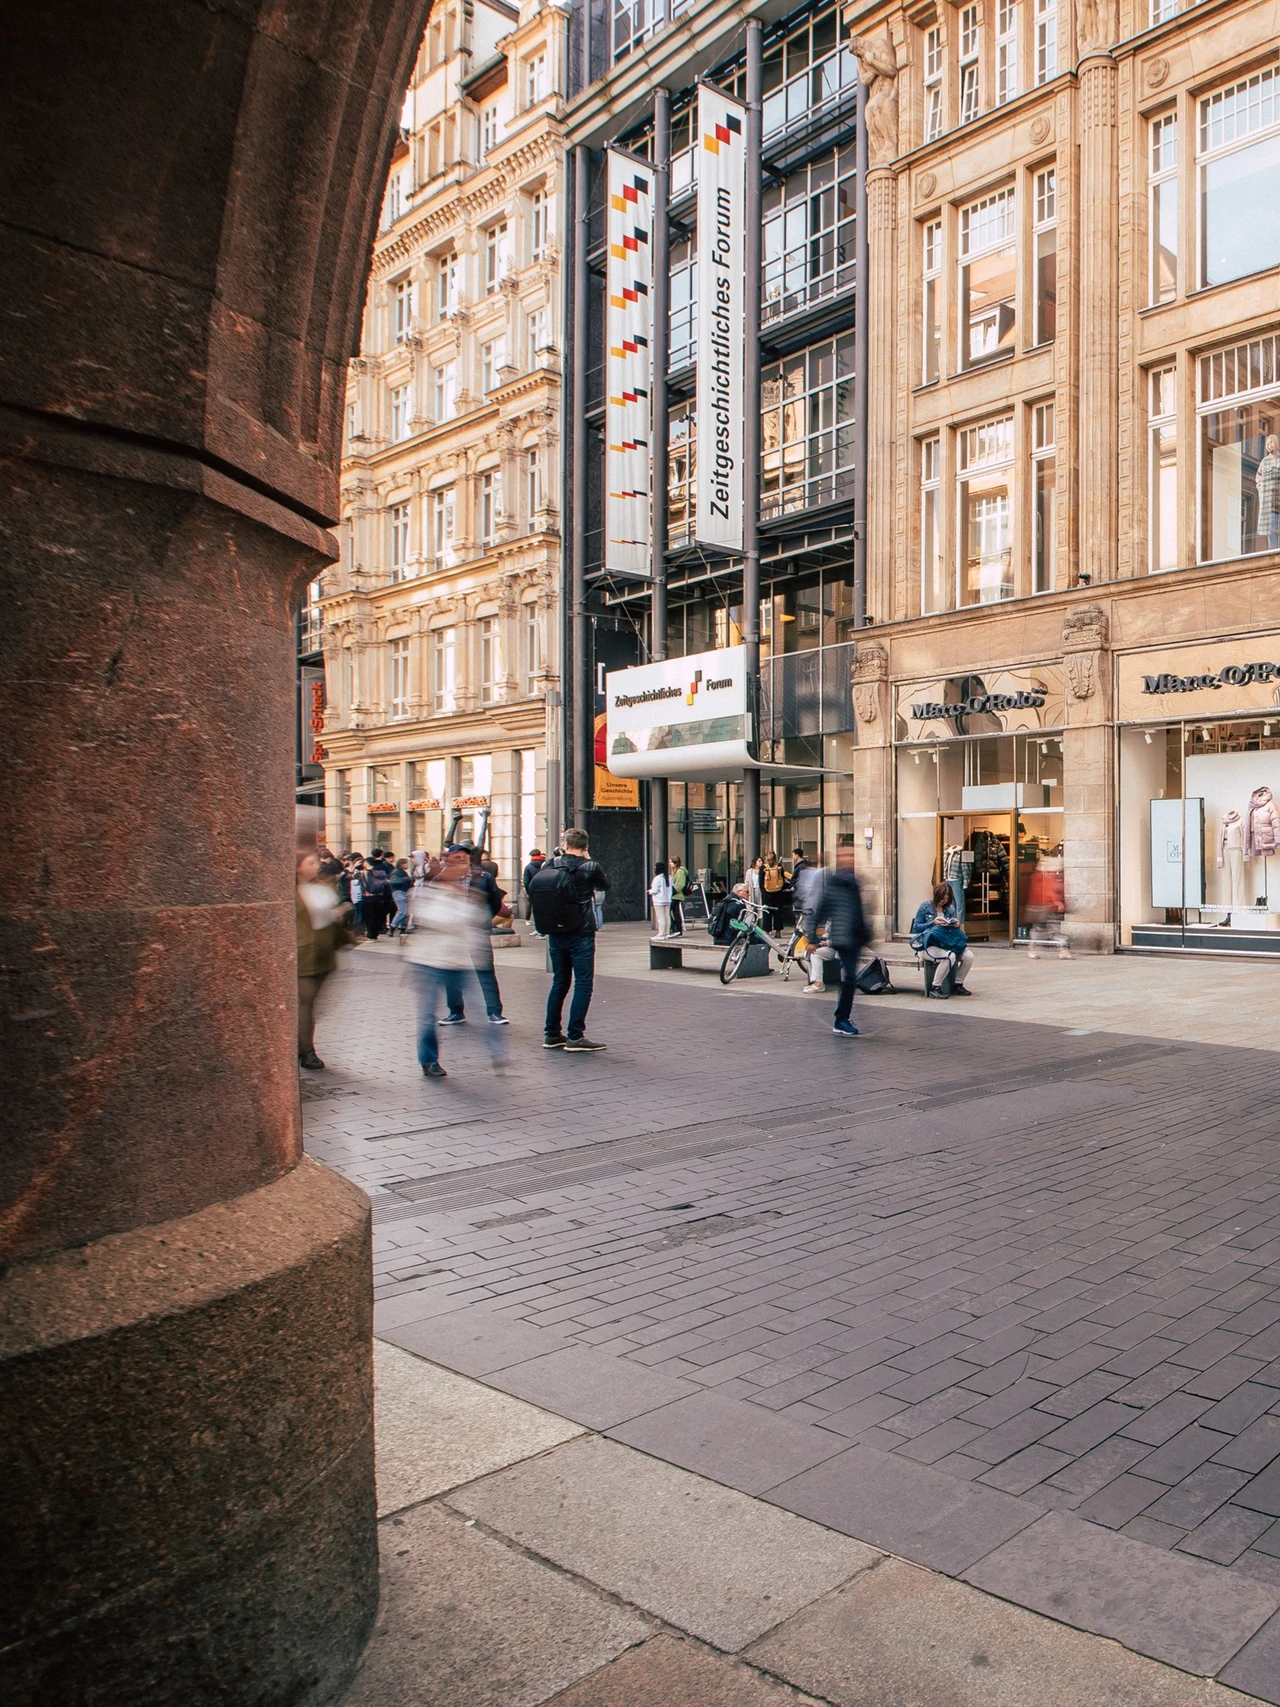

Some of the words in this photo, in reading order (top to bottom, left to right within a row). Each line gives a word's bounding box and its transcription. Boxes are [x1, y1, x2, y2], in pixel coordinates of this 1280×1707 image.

[711, 187, 732, 269] Forum
[709, 277, 734, 519] Zeitgeschichtliches
[614, 686, 683, 708] Zeitgeschichtliches
[706, 677, 733, 692] Forum
[1141, 673, 1218, 694] Marc
[910, 701, 965, 720] Marc
